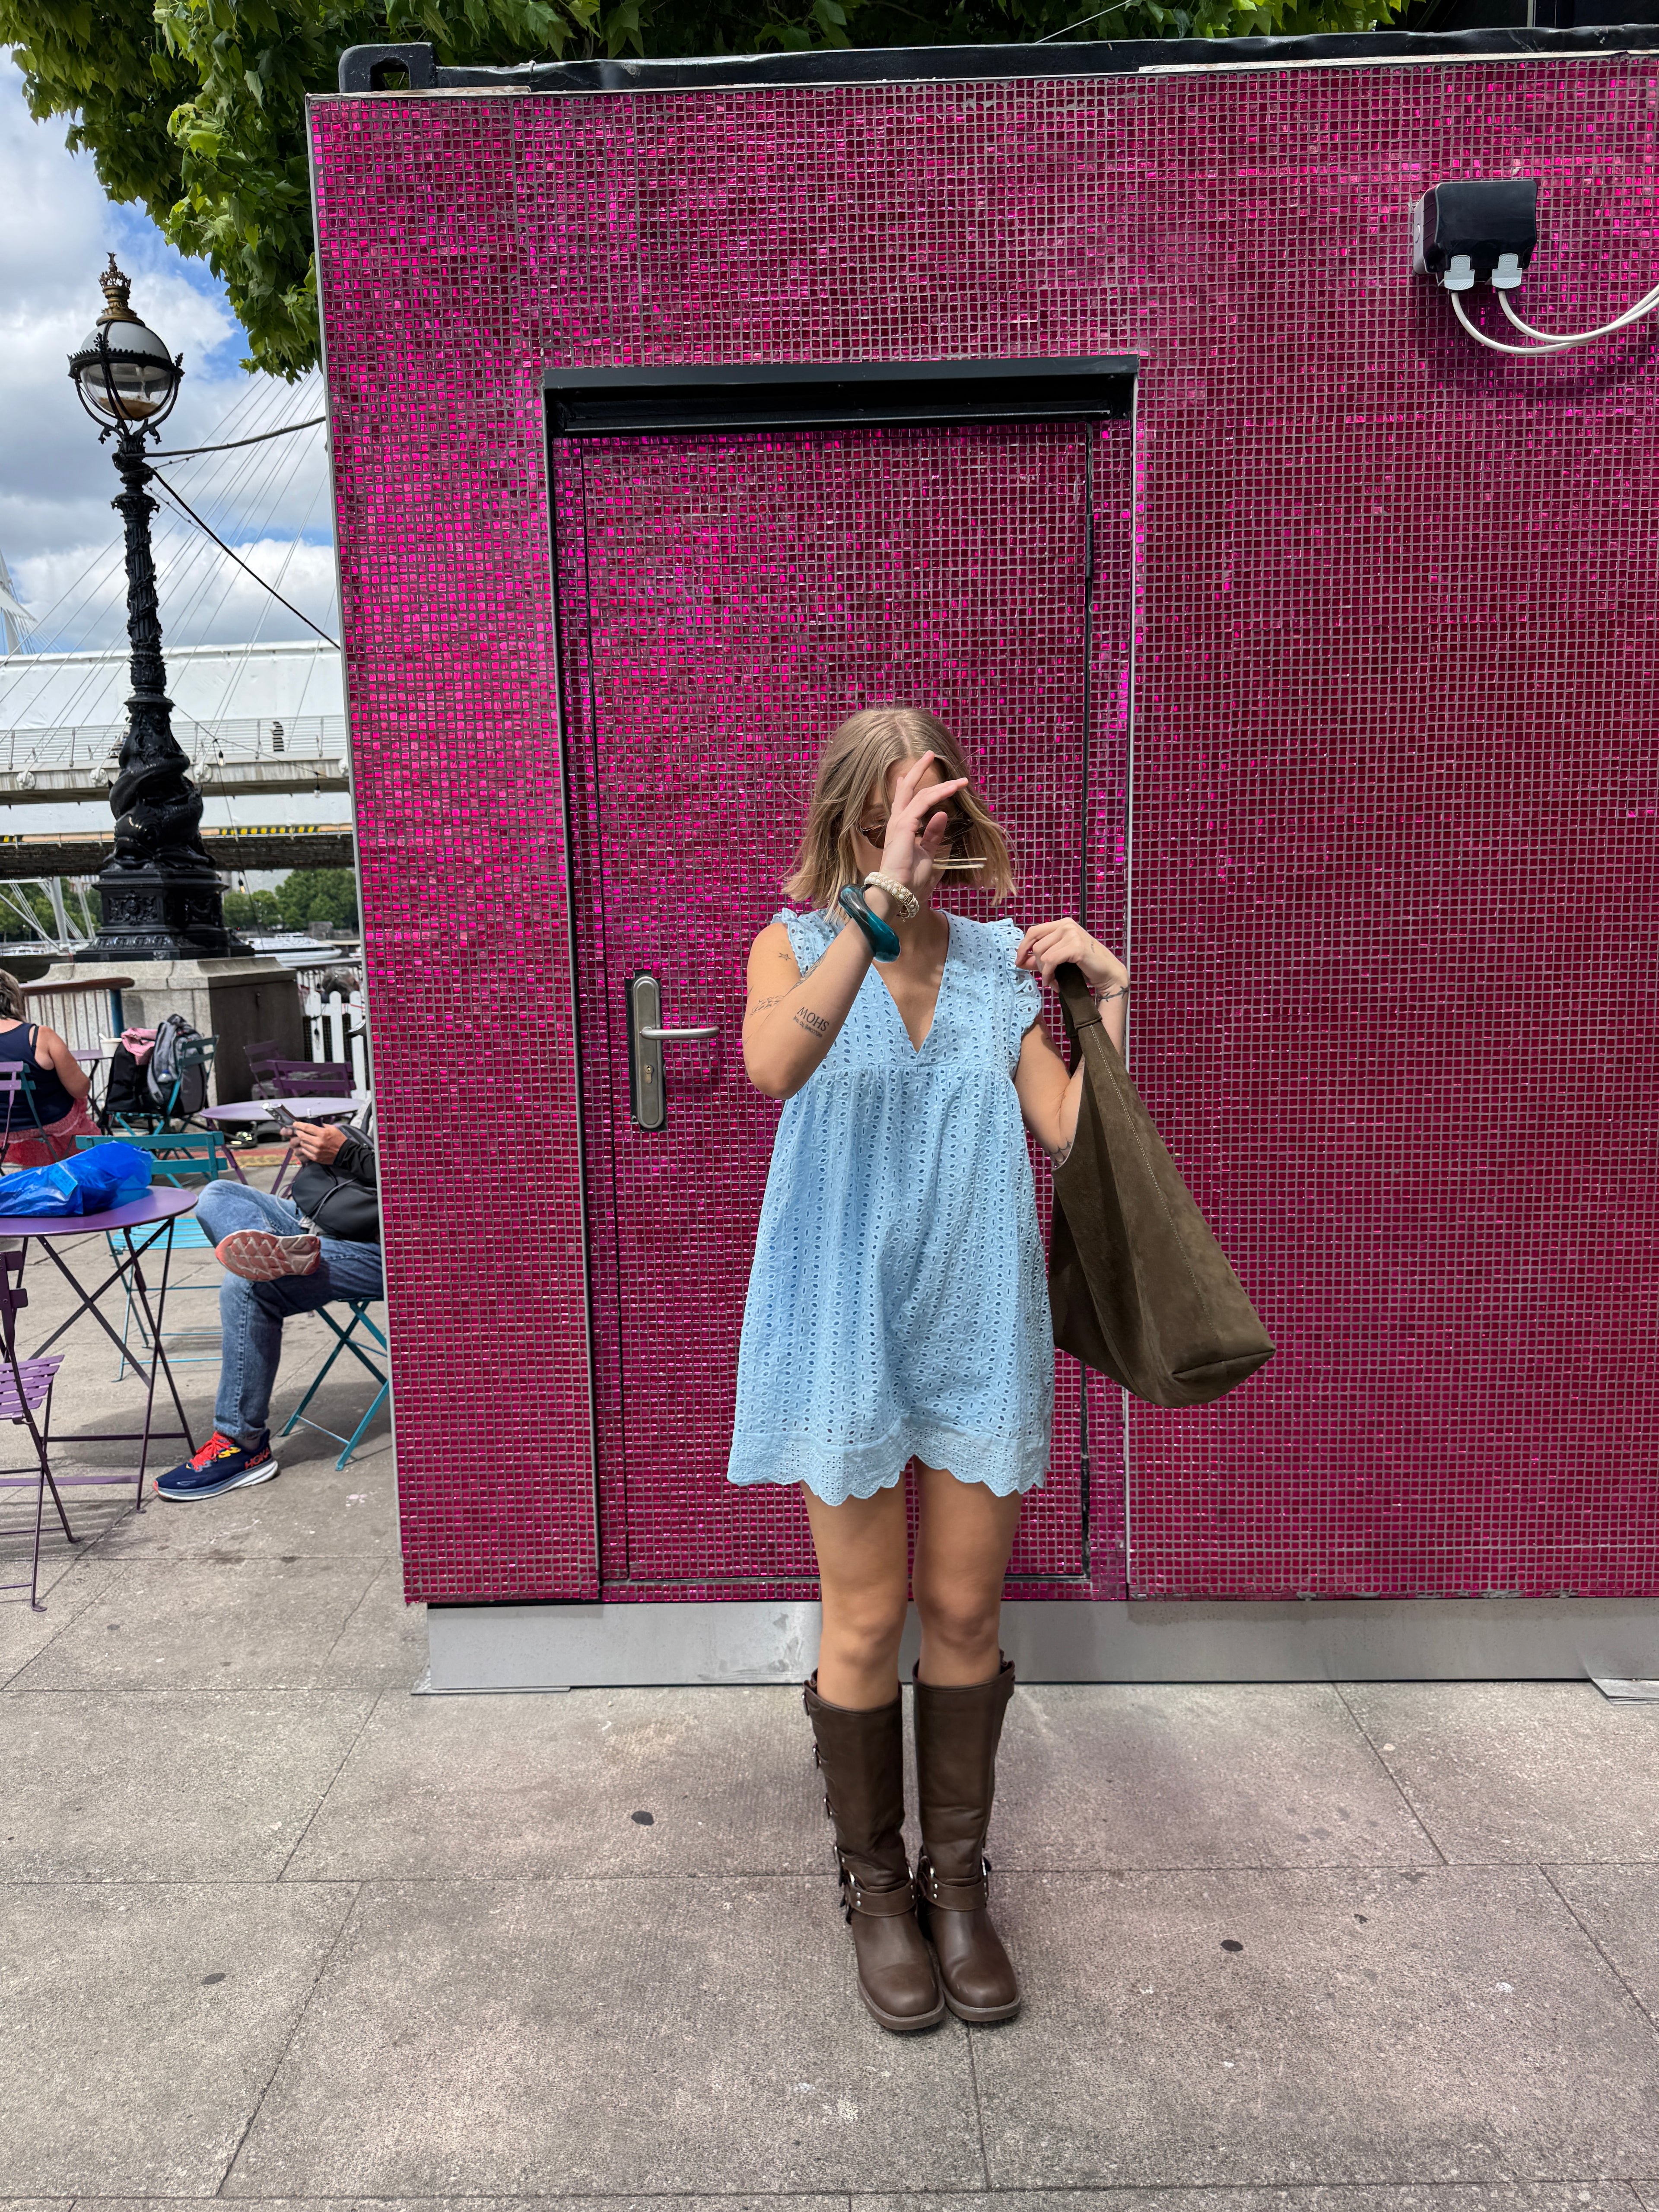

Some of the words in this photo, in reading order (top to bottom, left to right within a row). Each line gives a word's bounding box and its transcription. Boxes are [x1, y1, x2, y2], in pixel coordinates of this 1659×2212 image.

[797, 1006, 829, 1031] SHOW
[805, 1024, 822, 1037] WELCOME
[245, 1447, 270, 1470] HOKA
